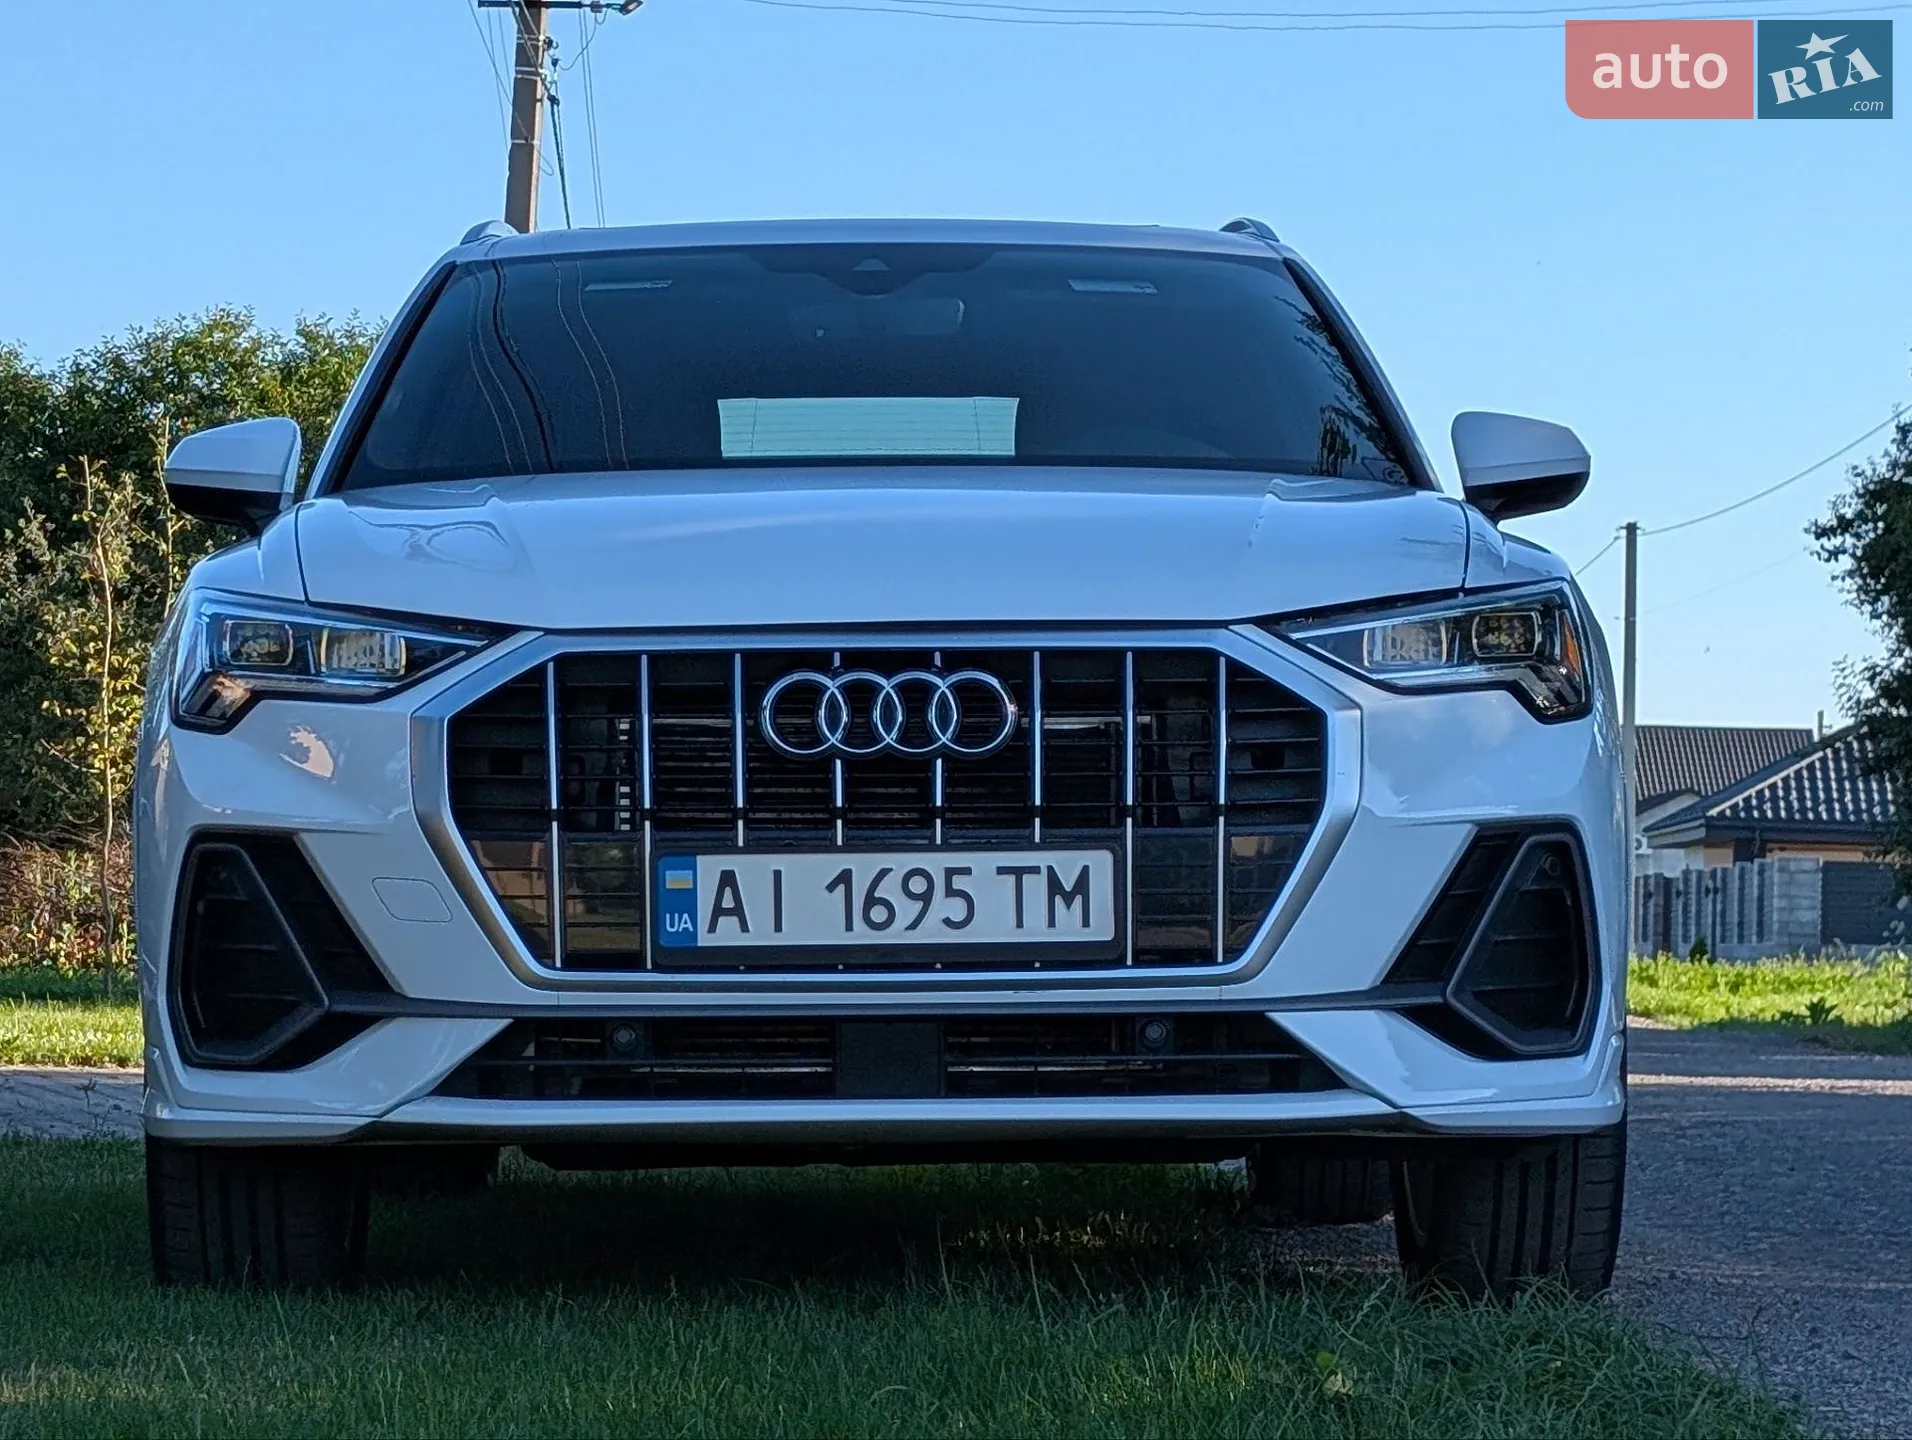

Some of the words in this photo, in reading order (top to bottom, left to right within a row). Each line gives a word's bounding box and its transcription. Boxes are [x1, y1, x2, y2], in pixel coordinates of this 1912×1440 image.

[707, 868, 783, 934] AI
[825, 867, 976, 932] 1695
[996, 865, 1090, 929] TM
[665, 913, 694, 932] UA
